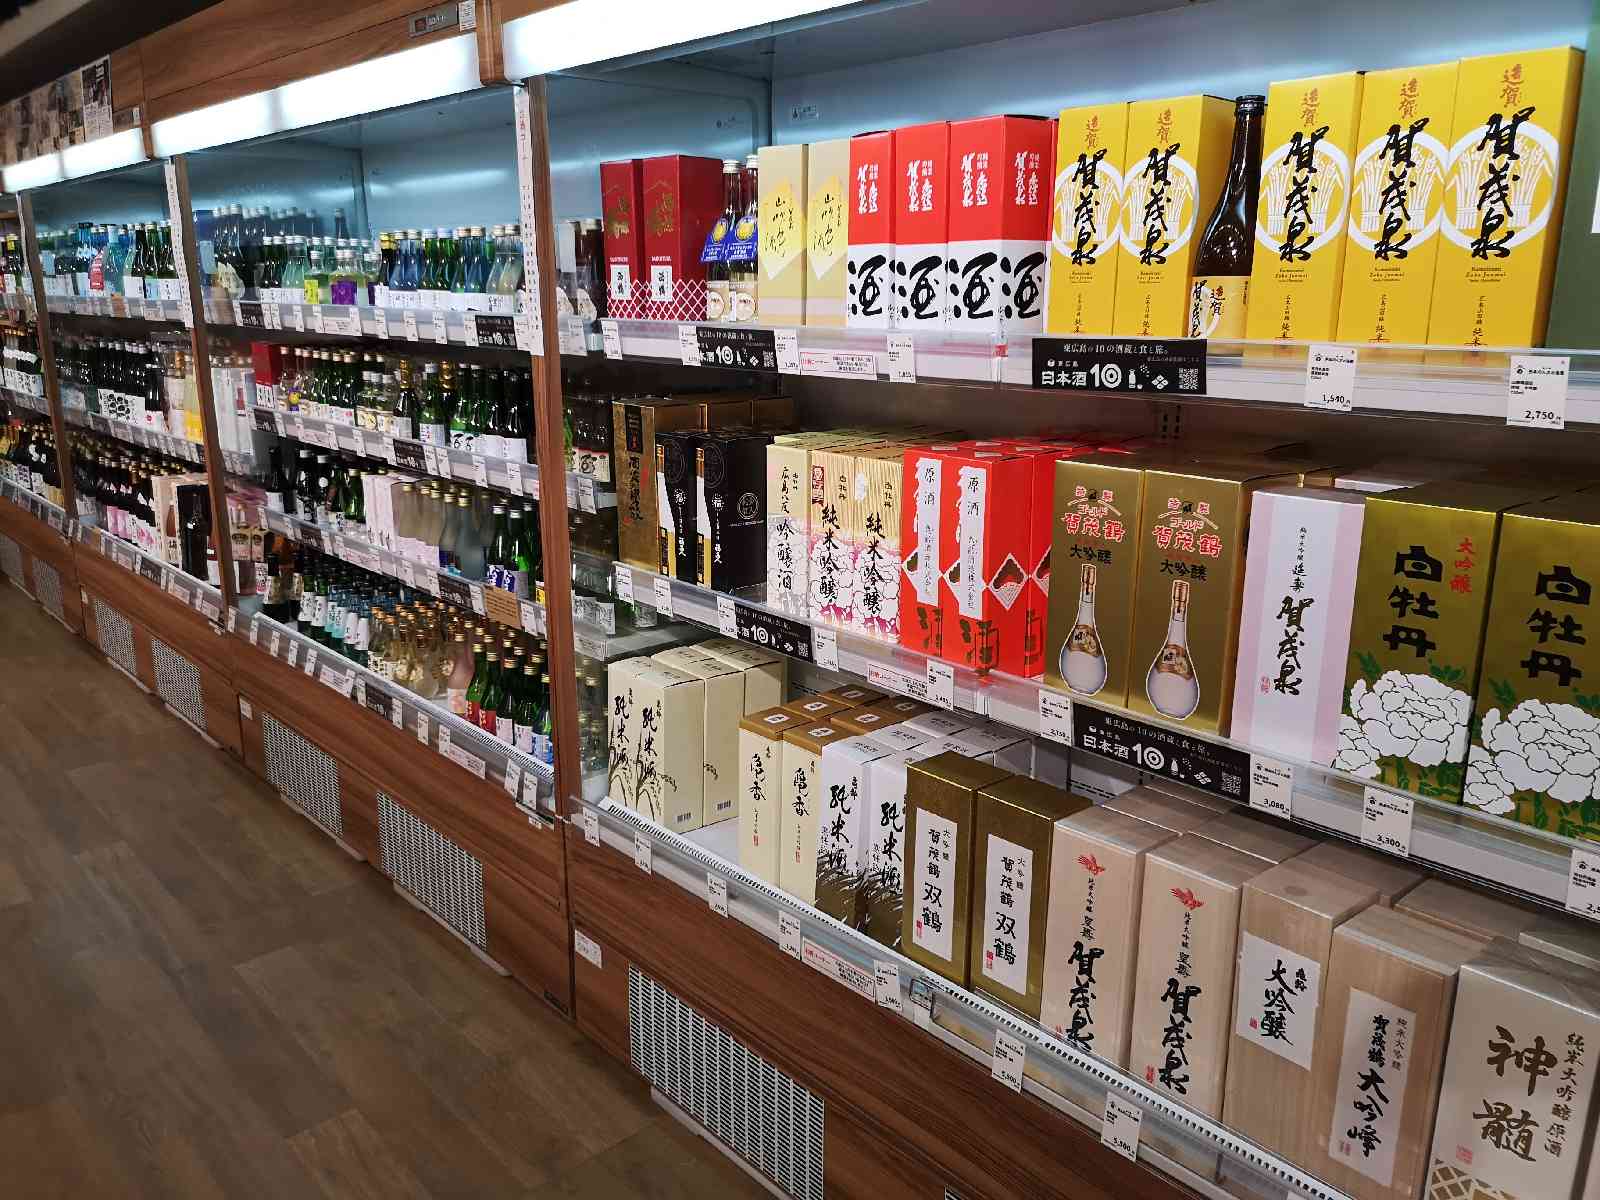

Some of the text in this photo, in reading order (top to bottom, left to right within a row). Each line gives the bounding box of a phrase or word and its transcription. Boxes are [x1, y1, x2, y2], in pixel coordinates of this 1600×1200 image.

[1072, 149, 1107, 266] 賀茂泉
[1140, 143, 1180, 266] 賀茂泉
[1279, 125, 1330, 263] 賀茂泉
[1374, 117, 1430, 262] 賀茂泉
[1470, 106, 1536, 260] 賀茂泉
[896, 255, 943, 319] 酒
[949, 252, 997, 319] 酒
[924, 467, 936, 506] 原酒
[967, 477, 980, 517] 原酒
[1062, 512, 1126, 543] 賀茂鶴
[776, 518, 795, 590] 吟醸酒
[819, 504, 840, 602] 純米吟醸
[863, 512, 885, 615] 純米吟醸
[1070, 545, 1112, 565] 大吟醸
[1152, 525, 1223, 557] 賀茂鶴
[1160, 560, 1208, 582] 大吟醸
[1273, 595, 1315, 697] 賀茂泉
[1383, 545, 1443, 658] 白牡丹
[1520, 564, 1592, 687] 白牡丹
[921, 828, 944, 934] 賀茂鶴 双鶴
[993, 856, 1017, 966] 賀茂鶴 双鶴
[1067, 941, 1105, 1052] 賀茂泉
[1158, 978, 1203, 1095] 賀茂泉
[1260, 959, 1298, 1047] 大吟醸
[1472, 1024, 1559, 1163] 神髄
